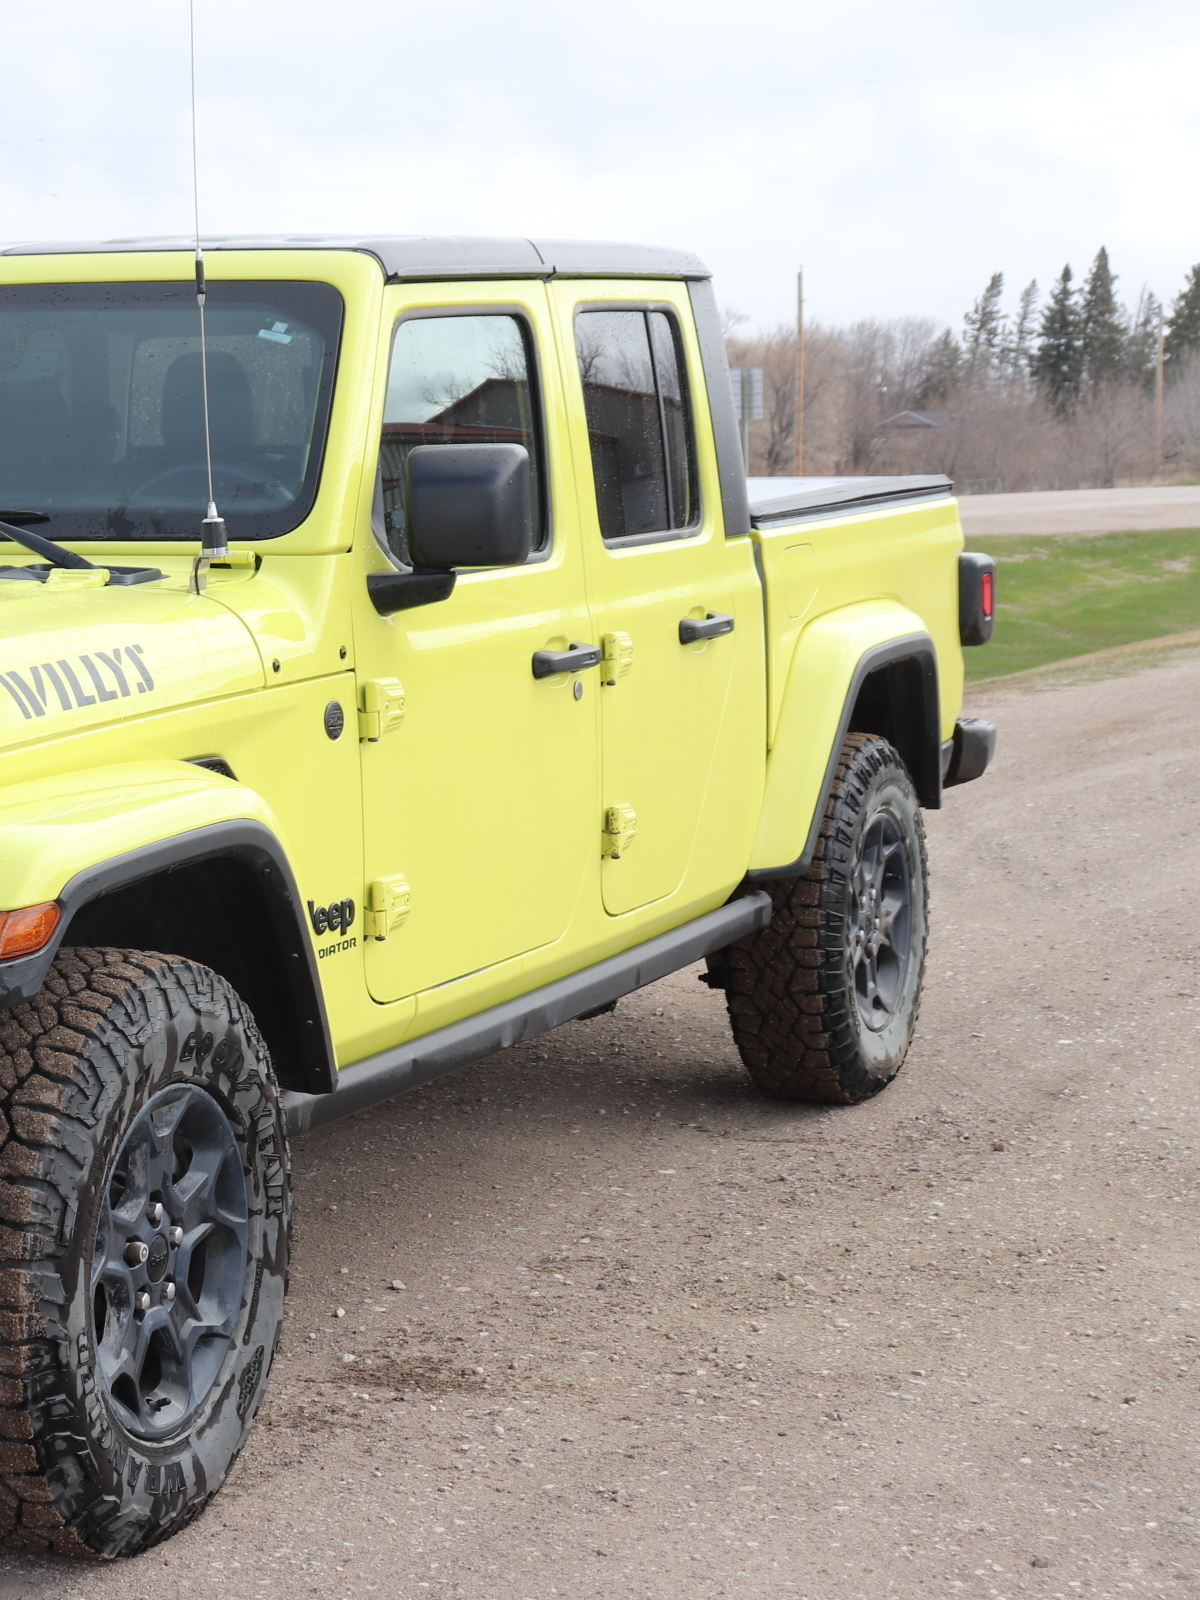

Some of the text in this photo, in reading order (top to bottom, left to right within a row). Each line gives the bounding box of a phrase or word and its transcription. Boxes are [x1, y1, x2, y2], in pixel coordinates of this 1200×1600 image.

[318, 937, 357, 959] DIATOR
[179, 1031, 285, 1219] GOODYEAR
[77, 1332, 187, 1494] WRANGLER
